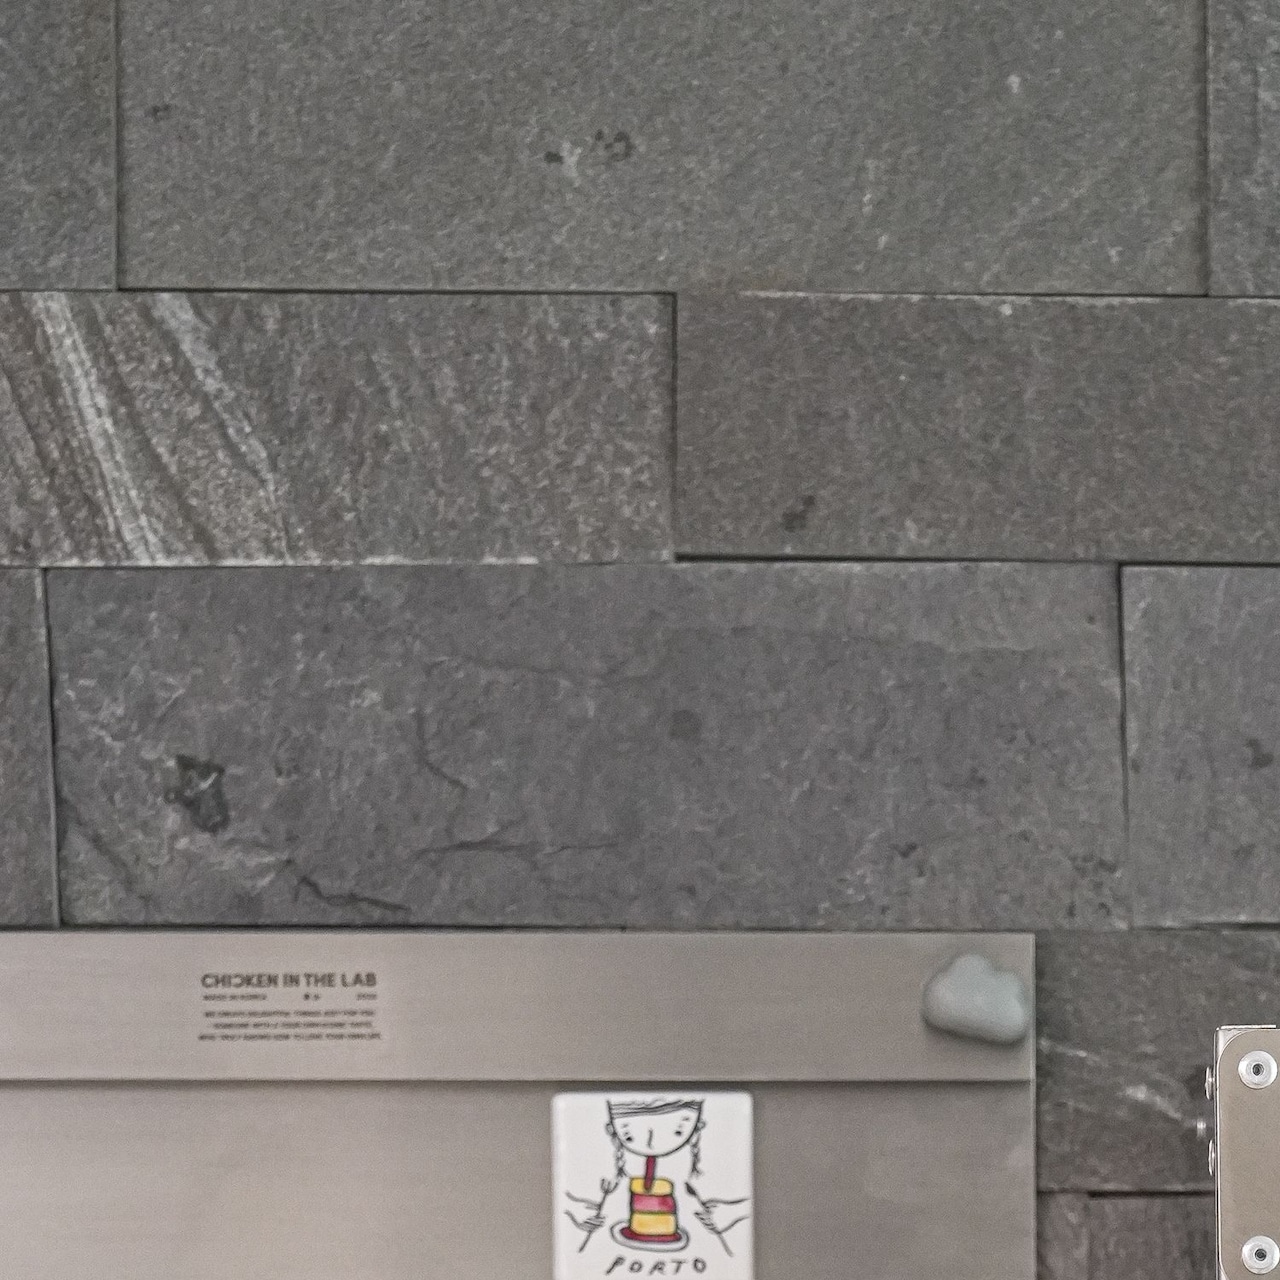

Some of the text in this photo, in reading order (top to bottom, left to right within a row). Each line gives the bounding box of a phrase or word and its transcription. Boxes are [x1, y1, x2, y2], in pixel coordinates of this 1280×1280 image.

[283, 974, 300, 988] IN
[303, 972, 336, 988] THE
[340, 972, 377, 988] LAB
[605, 1256, 707, 1275] PORTO
